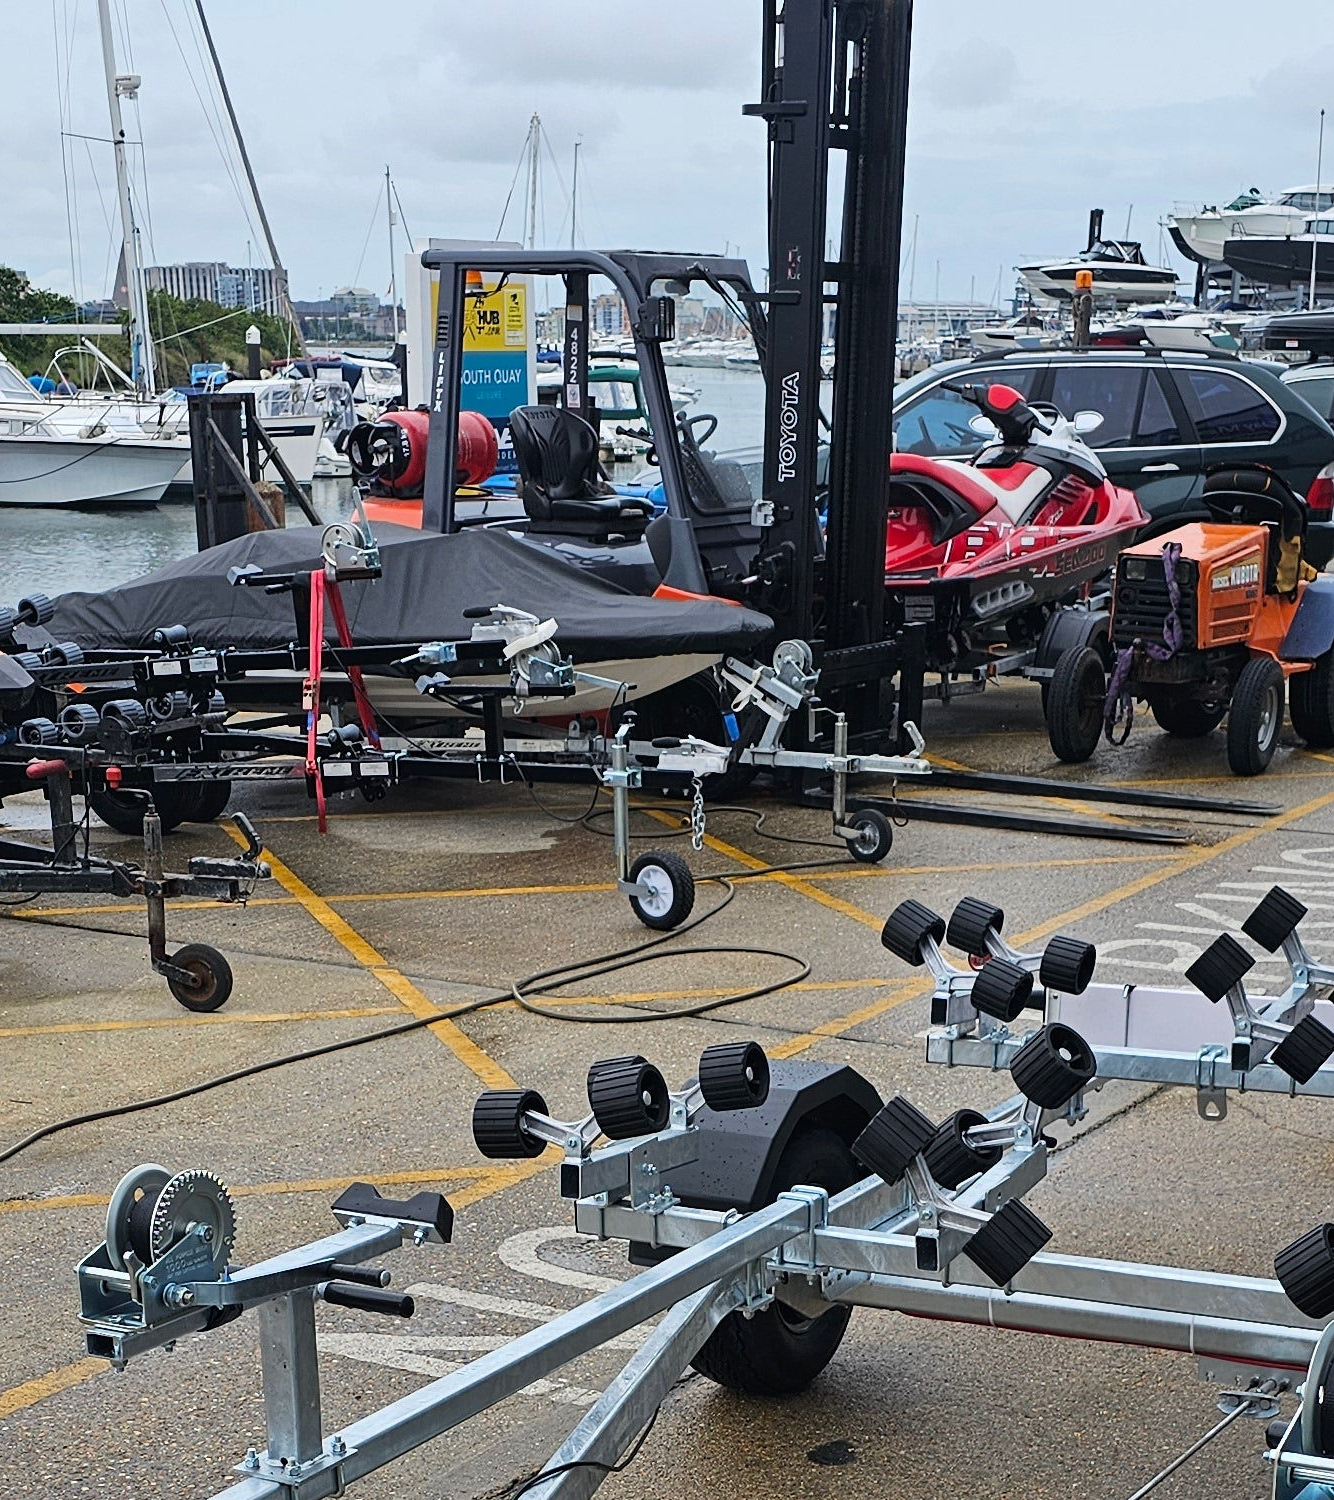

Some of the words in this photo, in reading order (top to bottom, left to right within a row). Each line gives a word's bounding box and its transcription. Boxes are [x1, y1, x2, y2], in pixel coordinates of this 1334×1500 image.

[477, 310, 500, 325] HUB
[569, 328, 579, 383] 4822
[460, 370, 494, 385] OUTH
[495, 369, 522, 385] QUAY
[778, 371, 800, 483] TOYOTA
